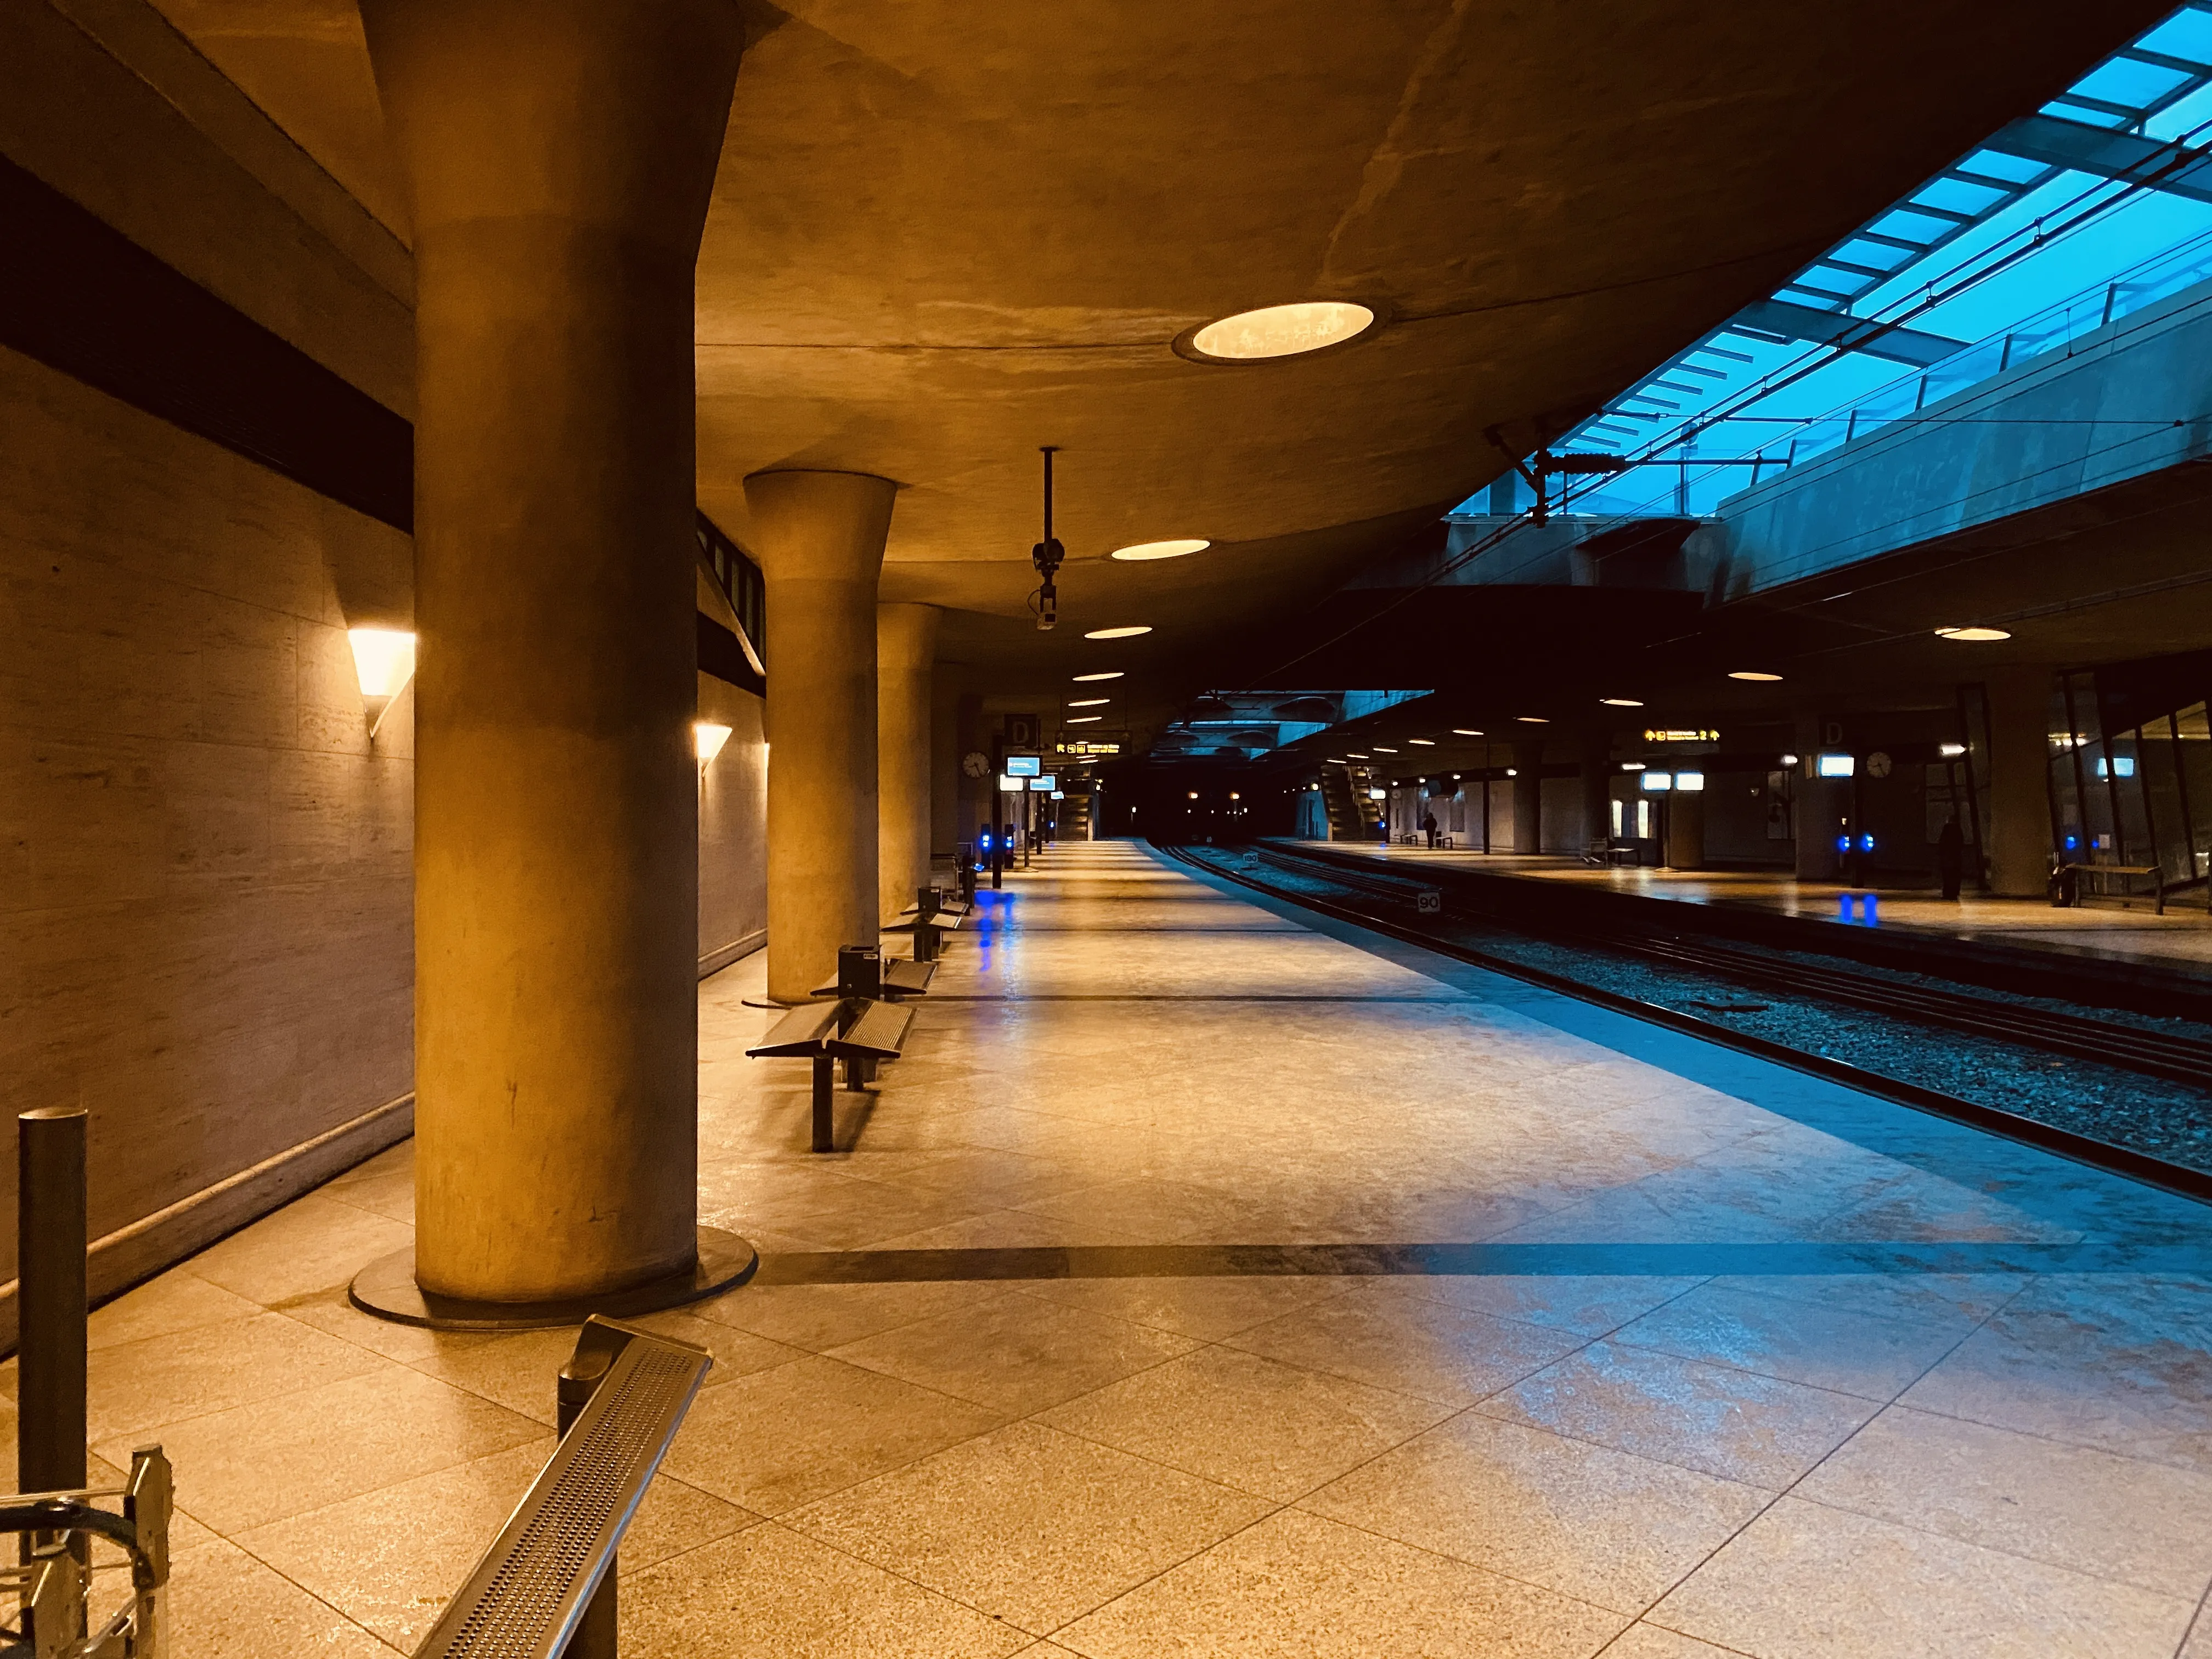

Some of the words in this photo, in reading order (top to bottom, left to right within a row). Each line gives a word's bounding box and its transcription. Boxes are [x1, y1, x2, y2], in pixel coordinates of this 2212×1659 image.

[1012, 721, 1029, 743] D
[1700, 731, 1707, 740] 2
[1826, 721, 1843, 744] D
[1419, 896, 1438, 909] 90
